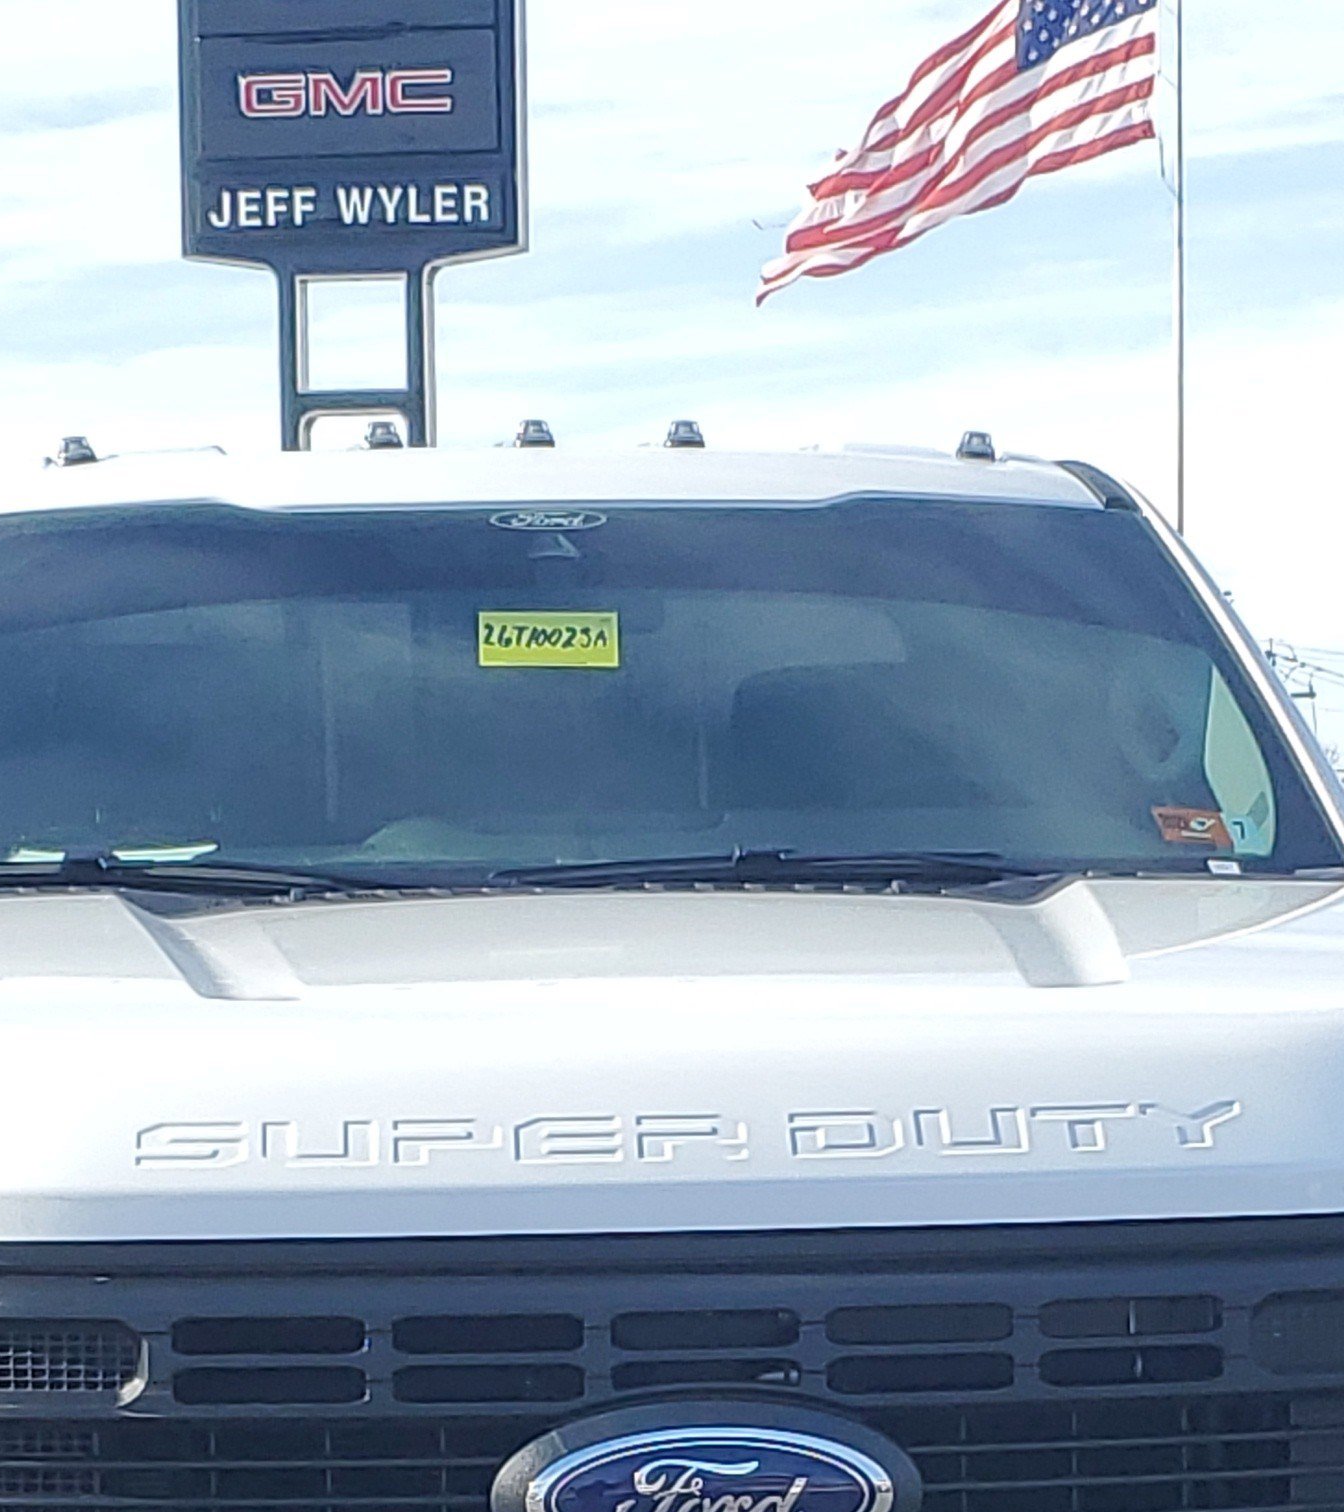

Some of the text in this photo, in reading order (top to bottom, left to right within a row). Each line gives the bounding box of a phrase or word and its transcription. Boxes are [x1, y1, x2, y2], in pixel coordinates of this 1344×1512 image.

[238, 68, 453, 118] GMC
[207, 184, 490, 228] JEFF WYLER
[510, 511, 586, 527] Ford
[133, 1098, 1243, 1169] SUPER DUTY
